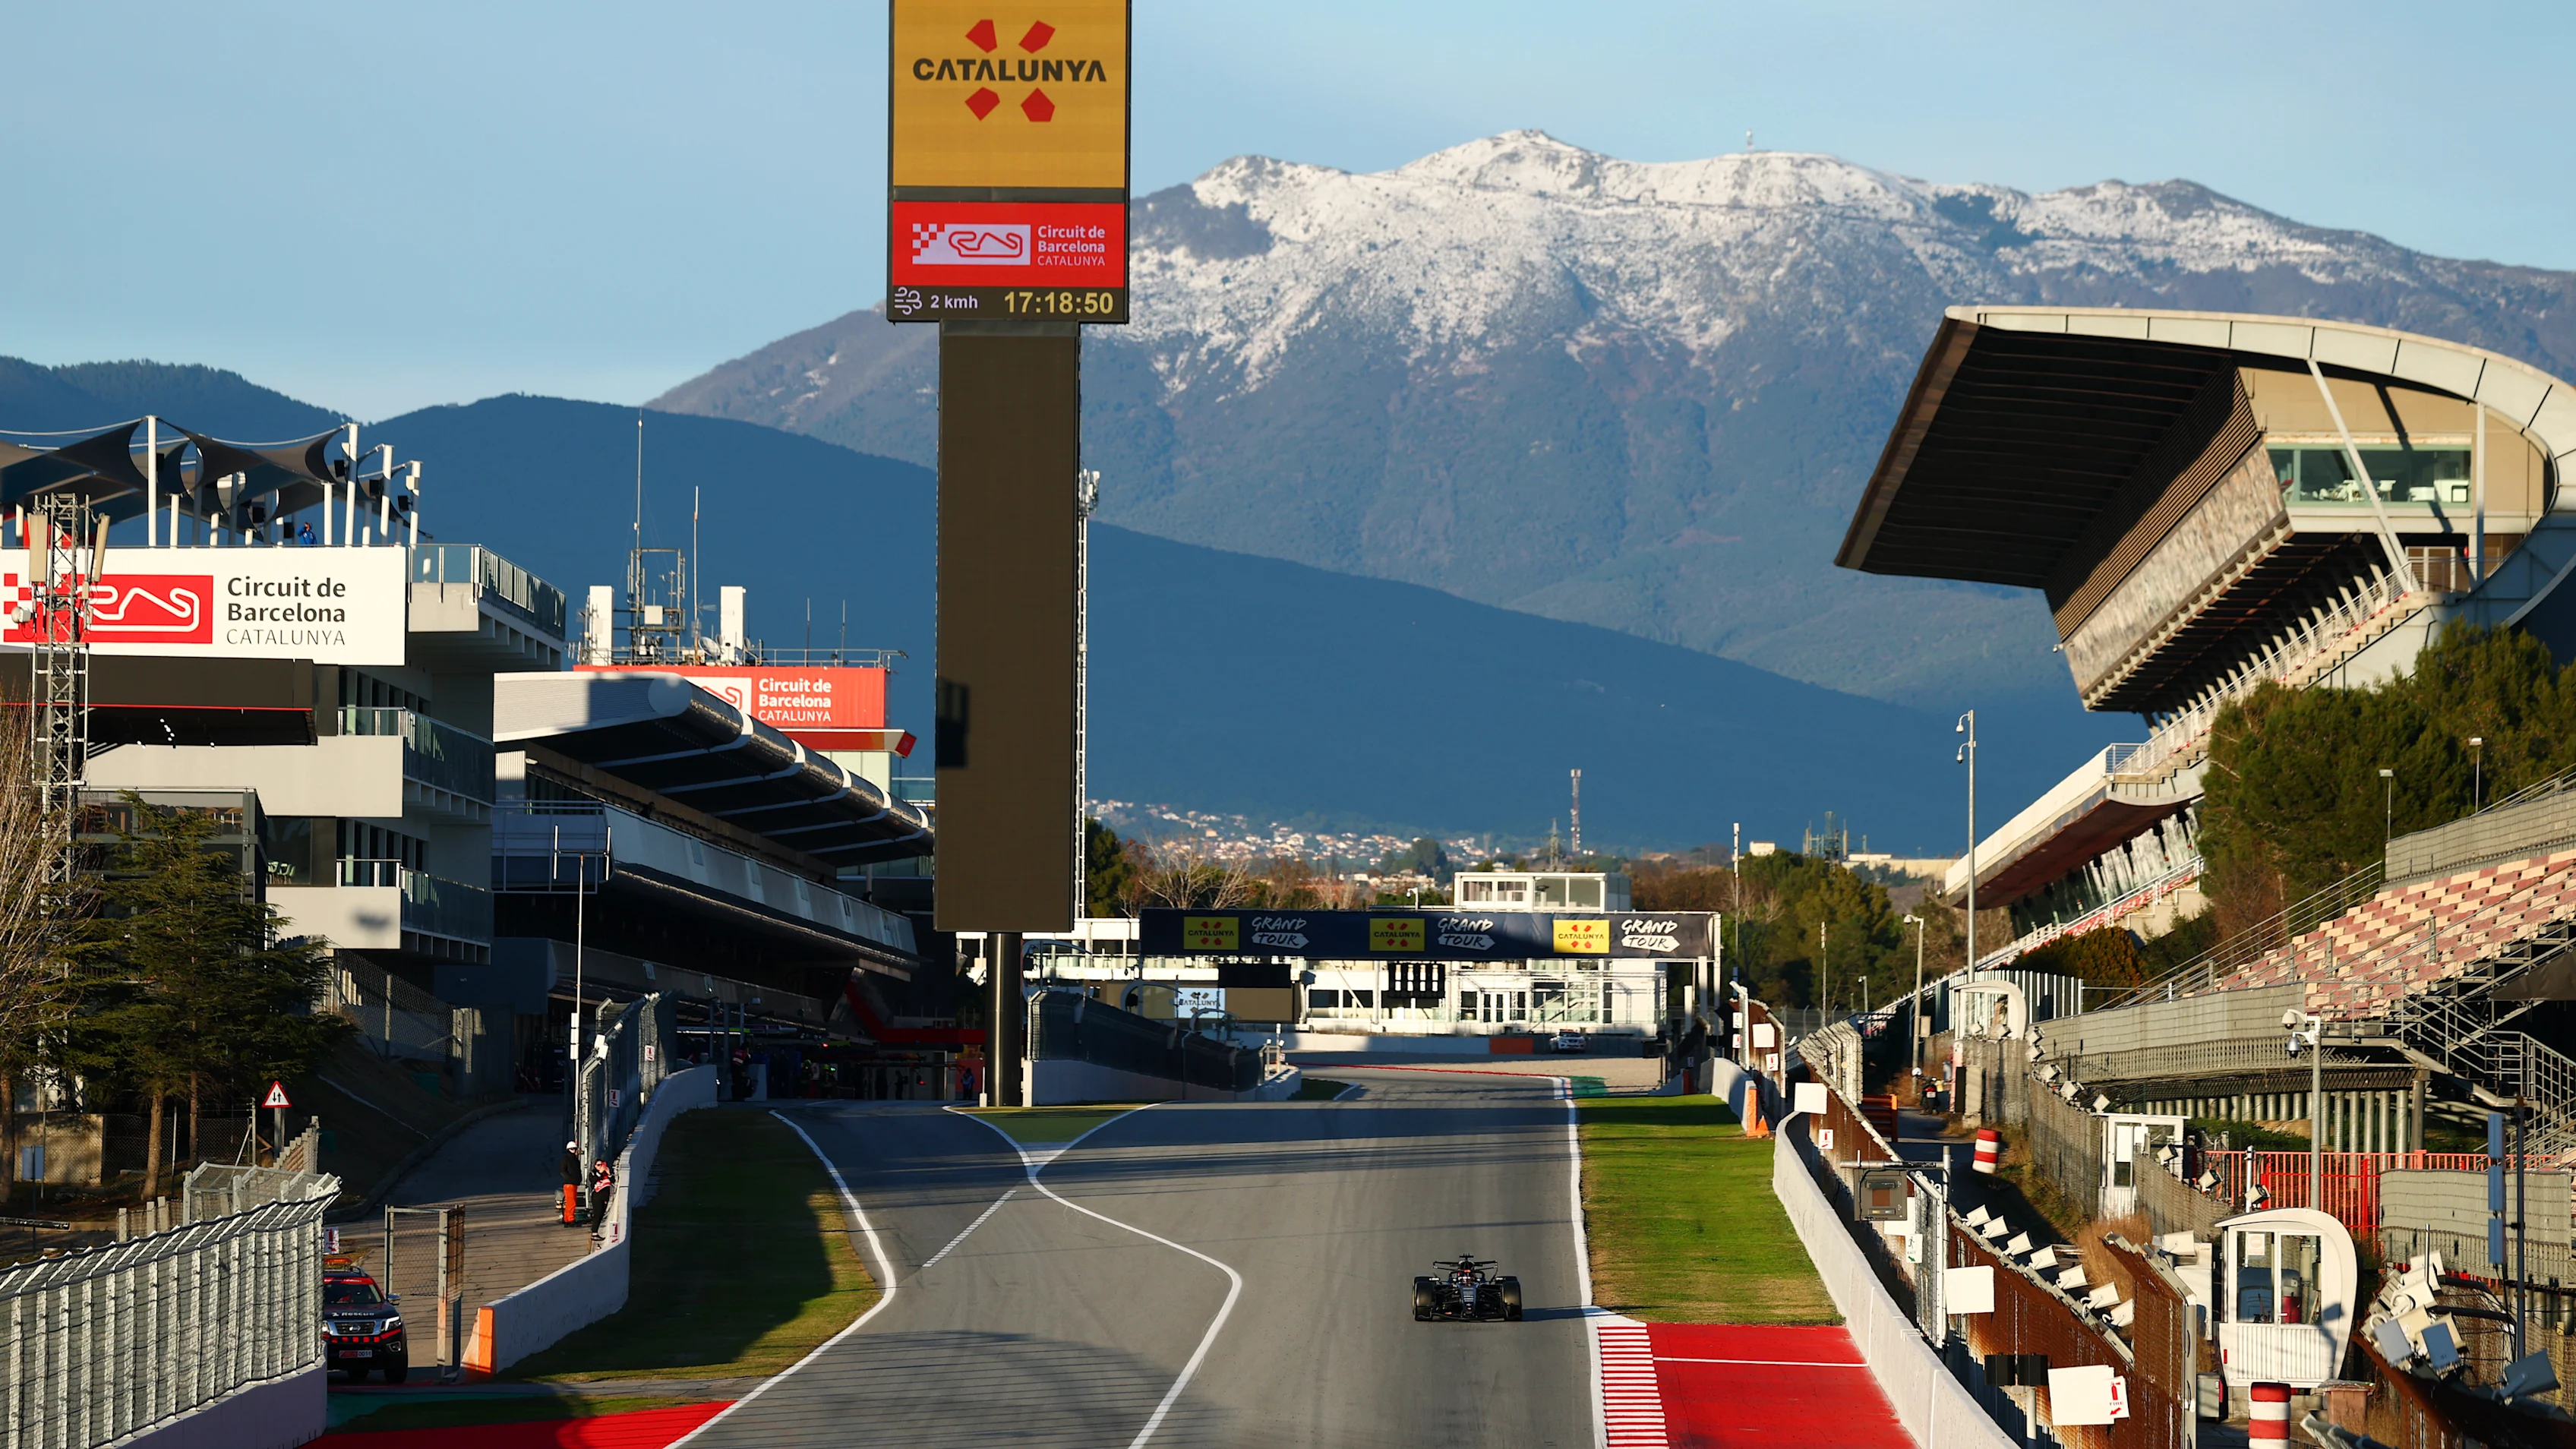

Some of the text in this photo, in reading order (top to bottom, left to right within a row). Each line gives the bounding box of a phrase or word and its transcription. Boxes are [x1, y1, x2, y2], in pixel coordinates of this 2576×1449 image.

[913, 58, 1106, 82] CATALUNYA
[1037, 225, 1106, 238] Circuit de
[1038, 240, 1105, 253] Barcelona
[1037, 255, 1106, 267] CATALUNYA
[930, 295, 978, 308] 2 kmh
[1004, 292, 1113, 314] 17:18:50
[227, 576, 346, 598] Circuit de
[228, 602, 346, 623] Barcelona
[226, 630, 346, 646] CATALUNYA
[759, 678, 832, 693] Circuit de
[759, 694, 832, 708] Barcelona
[758, 709, 832, 721] CATALUNYA
[1252, 917, 1307, 931] GRAND
[1438, 917, 1494, 933] GRAND
[1621, 919, 1678, 935] GRAND
[1258, 933, 1300, 946] TOUR
[1444, 935, 1485, 948] TOUR
[1628, 936, 1669, 949] TOUR
